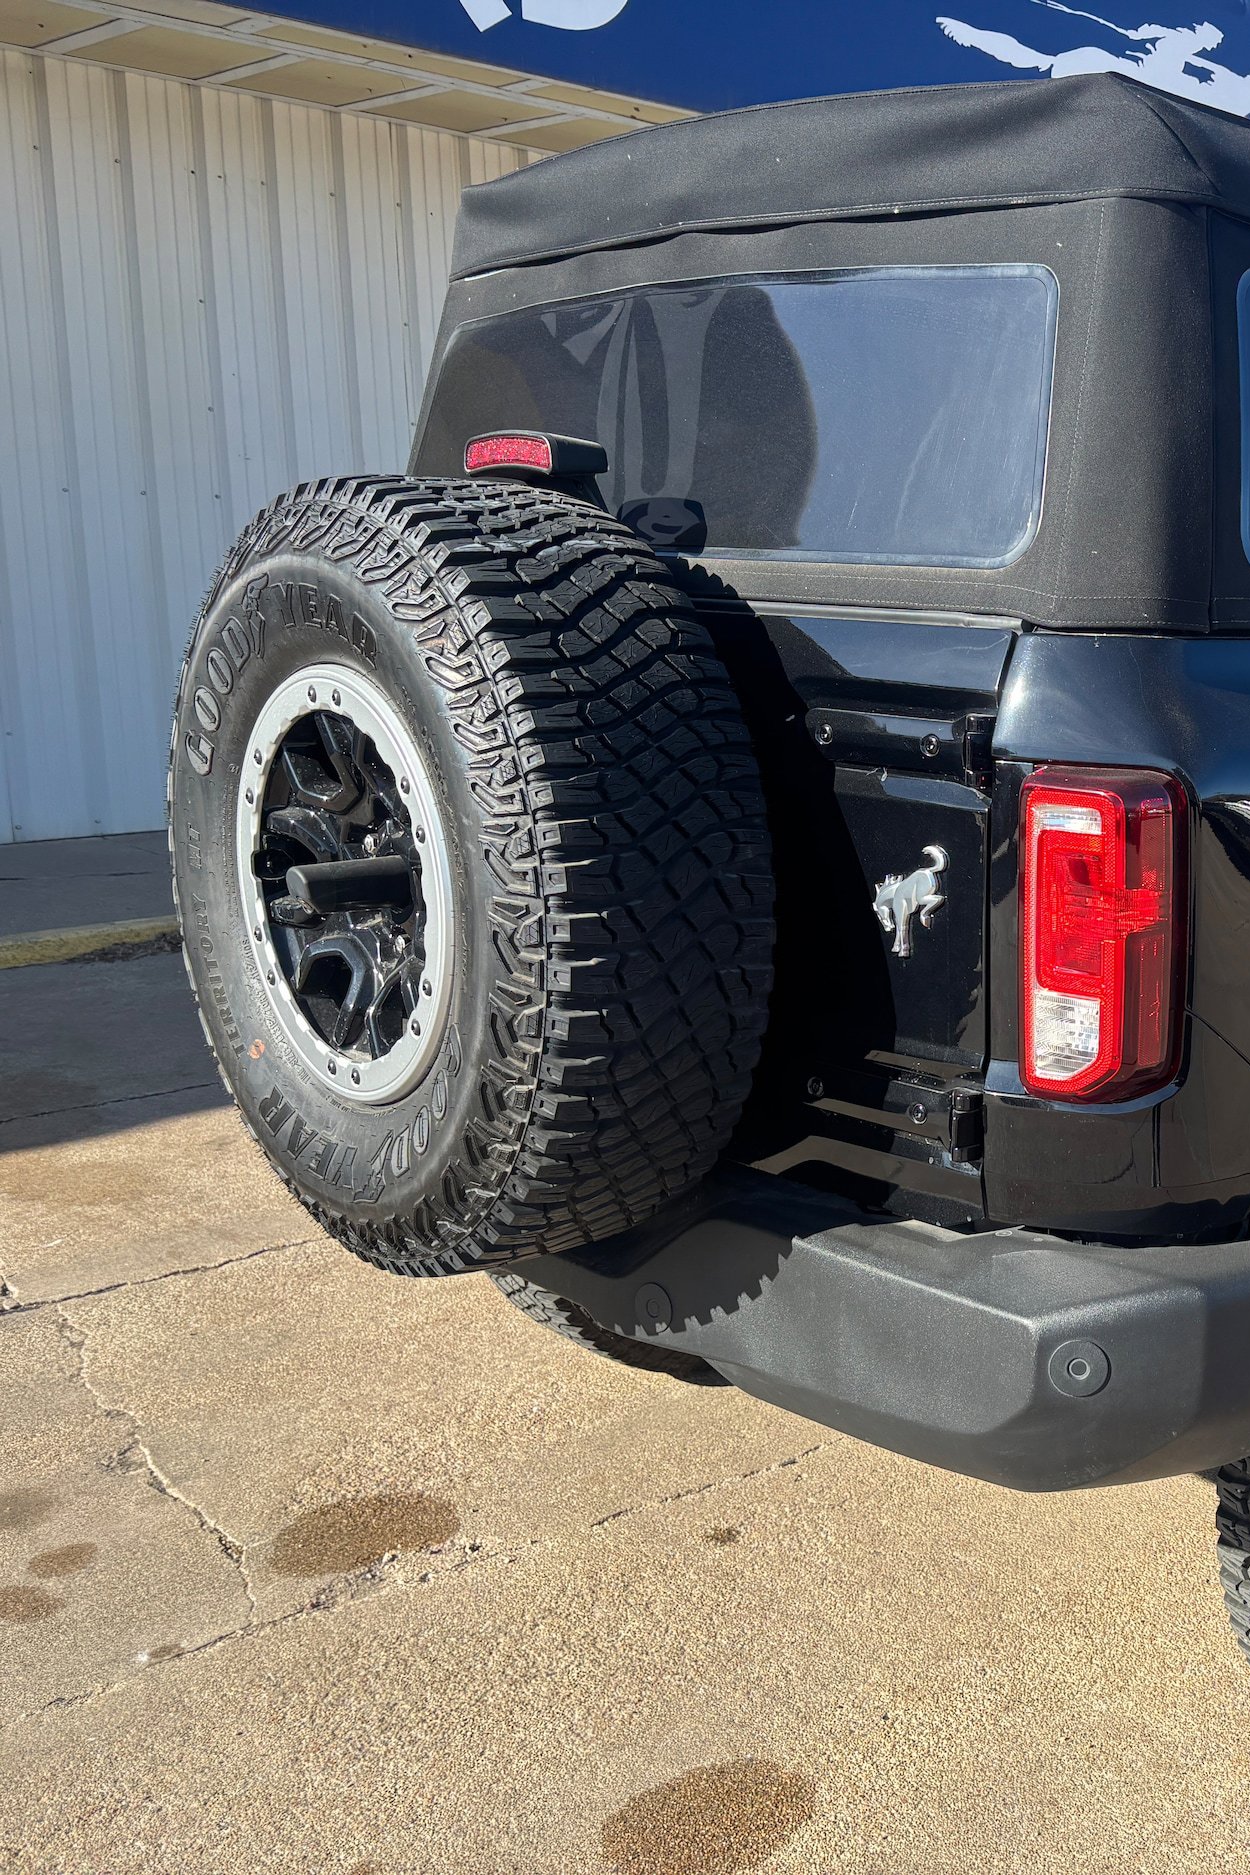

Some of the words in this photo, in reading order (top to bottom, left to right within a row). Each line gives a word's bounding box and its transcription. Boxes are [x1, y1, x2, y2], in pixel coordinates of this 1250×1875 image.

[186, 573, 378, 776] GOODYEAR
[191, 892, 246, 1060] TERRITORY
[259, 1023, 462, 1205] GOODYEAR
